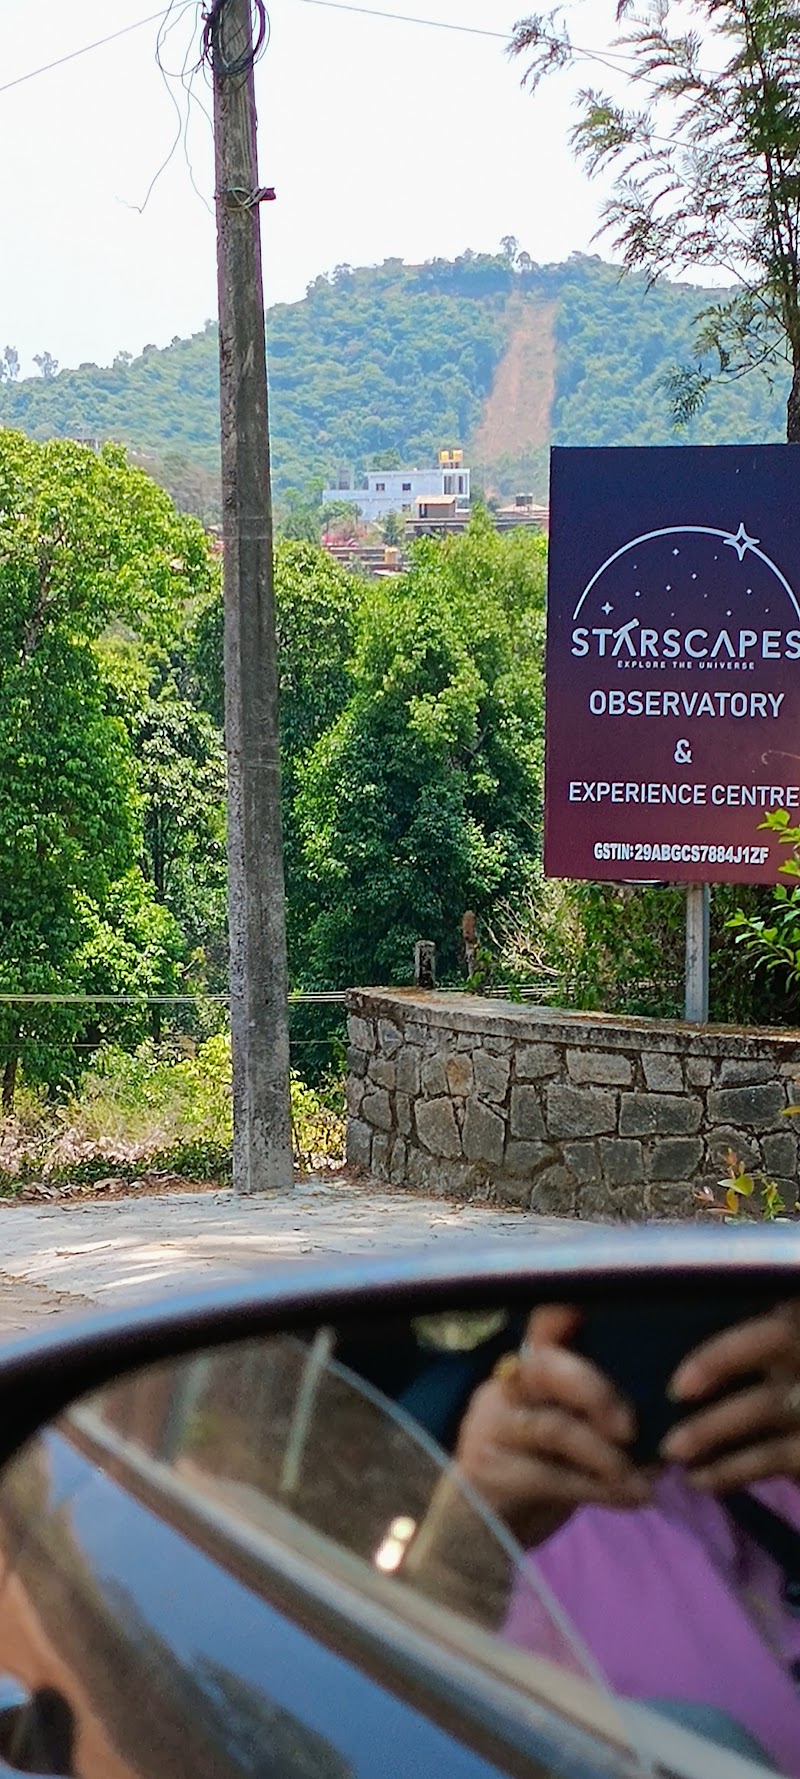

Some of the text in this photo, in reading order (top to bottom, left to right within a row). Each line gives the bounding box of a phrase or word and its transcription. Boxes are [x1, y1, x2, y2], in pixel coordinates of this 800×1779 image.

[571, 618, 800, 659] STARSCAPES
[617, 660, 755, 670] EXPLORE THE UNIVERSE
[589, 690, 785, 718] OBSERVATORY
[673, 738, 693, 764] &
[568, 781, 800, 807] EXPERIENCE CENTRE
